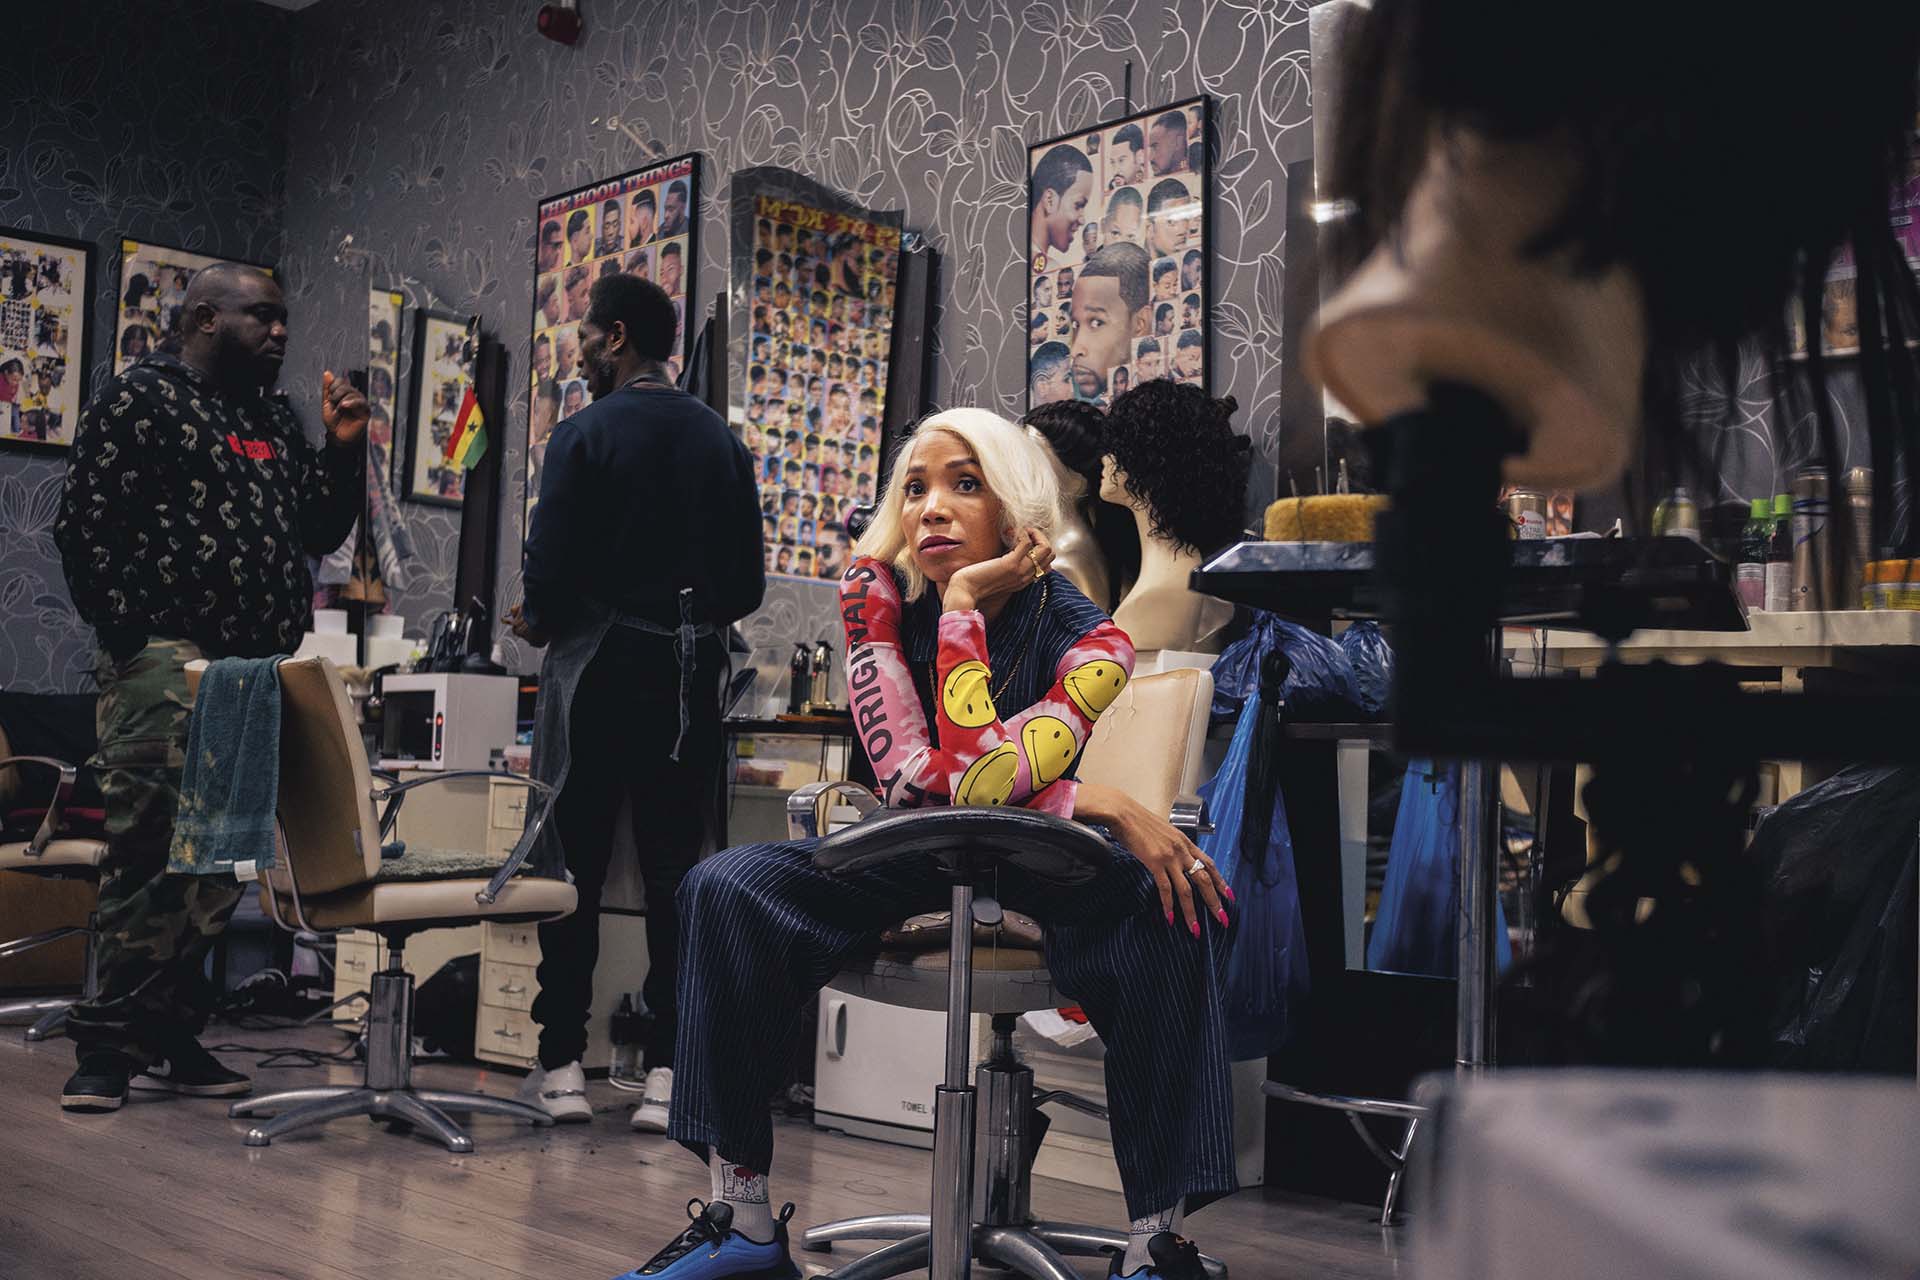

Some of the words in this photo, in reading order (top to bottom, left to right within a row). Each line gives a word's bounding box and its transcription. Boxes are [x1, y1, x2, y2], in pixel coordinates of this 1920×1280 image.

[540, 196, 572, 220] THE
[573, 180, 621, 209] HOOD
[623, 156, 694, 193] THINGS
[842, 563, 893, 763] ORIGINALS
[901, 1100, 927, 1114] TOWEL
